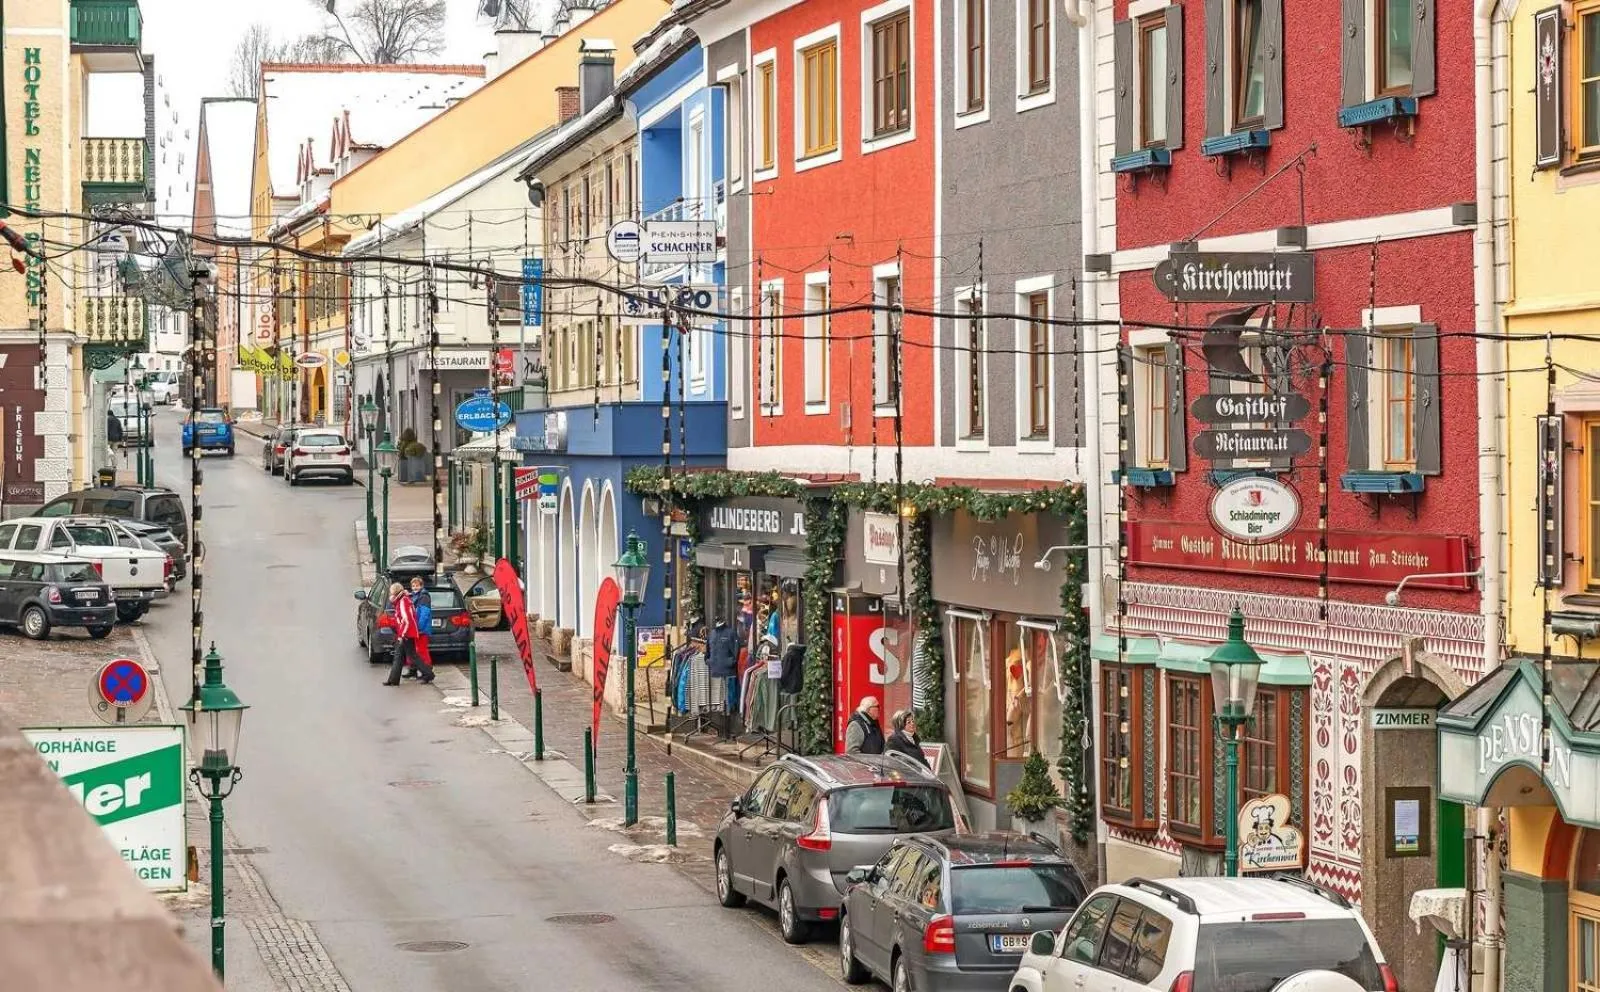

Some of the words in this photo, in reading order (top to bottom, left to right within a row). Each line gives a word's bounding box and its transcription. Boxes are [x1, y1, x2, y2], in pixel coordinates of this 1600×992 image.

[24, 47, 41, 137] HOTEL
[651, 242, 713, 252] SCHACHNER
[1182, 262, 1293, 299] Kirchenwirt
[648, 290, 712, 309] HPO
[711, 507, 779, 532] J.LINDEBERG
[1229, 510, 1281, 523] Schladminger
[1247, 523, 1263, 533] Bier
[1221, 536, 1297, 567] Kirchenwirt
[1305, 541, 1360, 564] Reaurant
[1376, 713, 1430, 726] ZIMMER
[1479, 712, 1572, 788] PENSION
[121, 846, 171, 860] ELÄGE
[1245, 852, 1297, 868] Kirchenwirt
[134, 867, 171, 879] GEN
